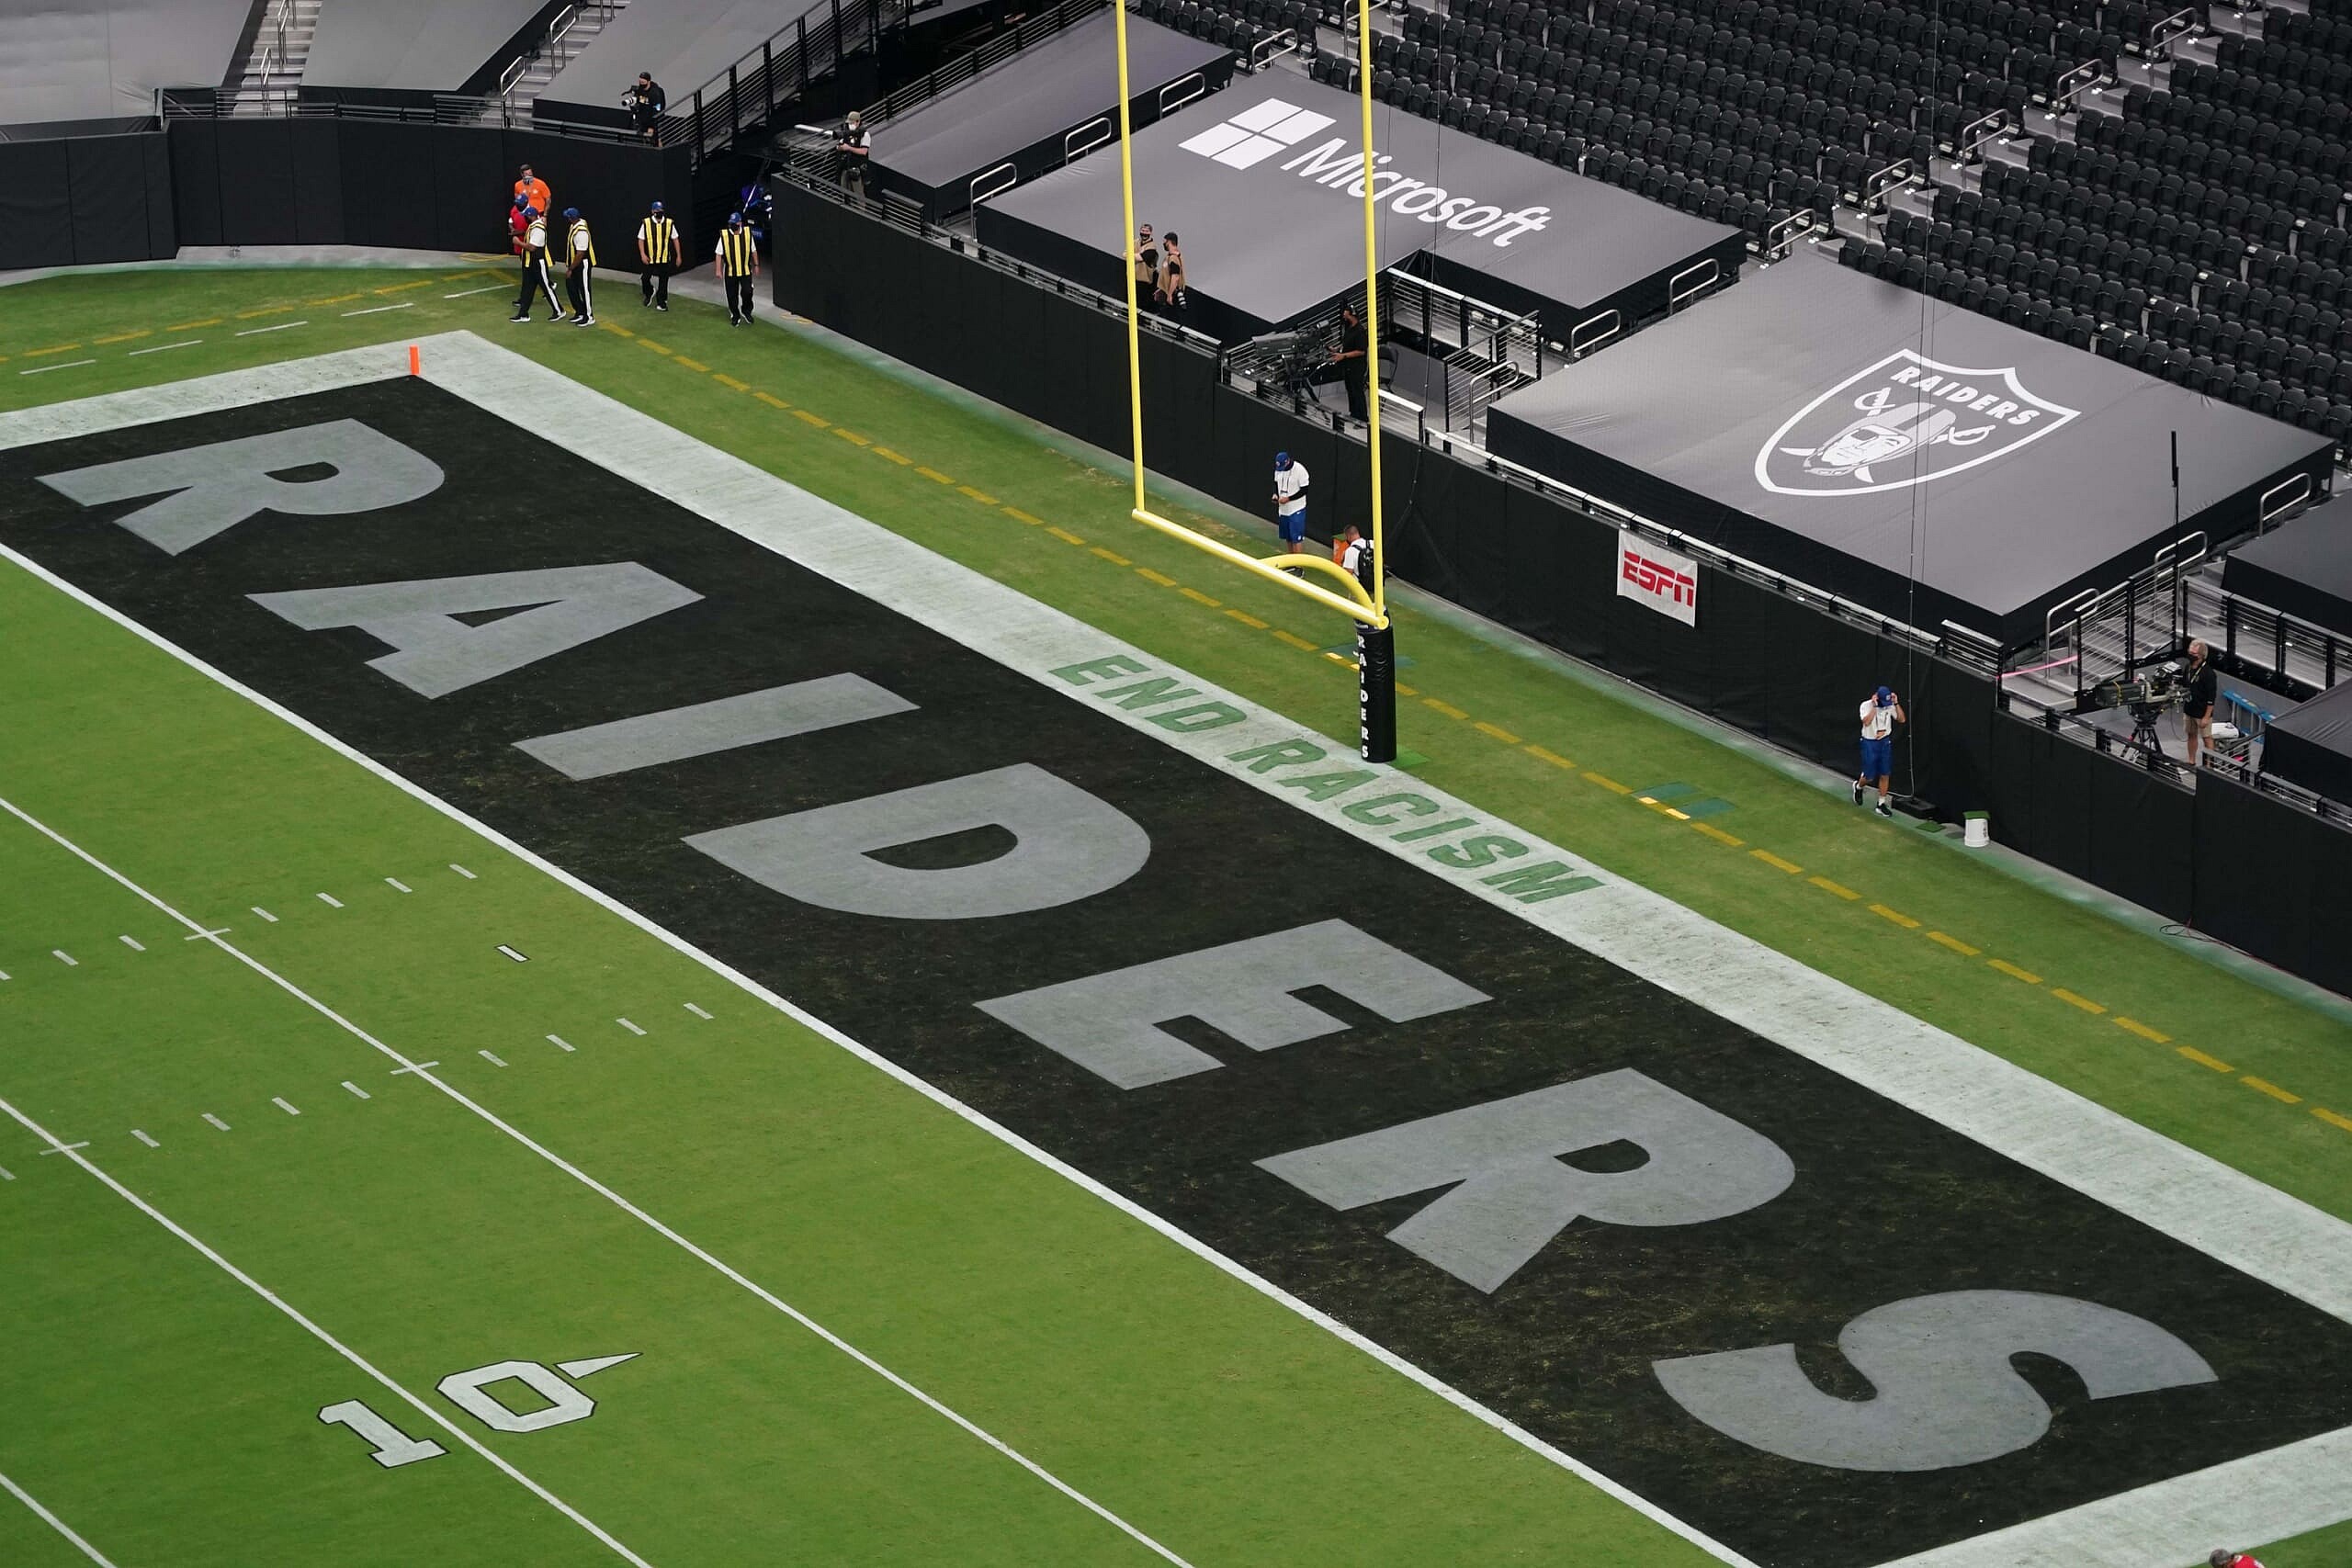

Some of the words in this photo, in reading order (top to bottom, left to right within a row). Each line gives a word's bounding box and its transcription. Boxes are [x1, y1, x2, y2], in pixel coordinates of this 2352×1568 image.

[1280, 137, 1552, 247] Microsoft
[1890, 366, 2041, 425] RAIDERS
[1623, 549, 1694, 608] ESPN
[1357, 634, 1369, 758] RAIDERS
[1048, 654, 1247, 733] END
[1225, 739, 1607, 905] RACISM
[35, 418, 2219, 1472] RAIDERS
